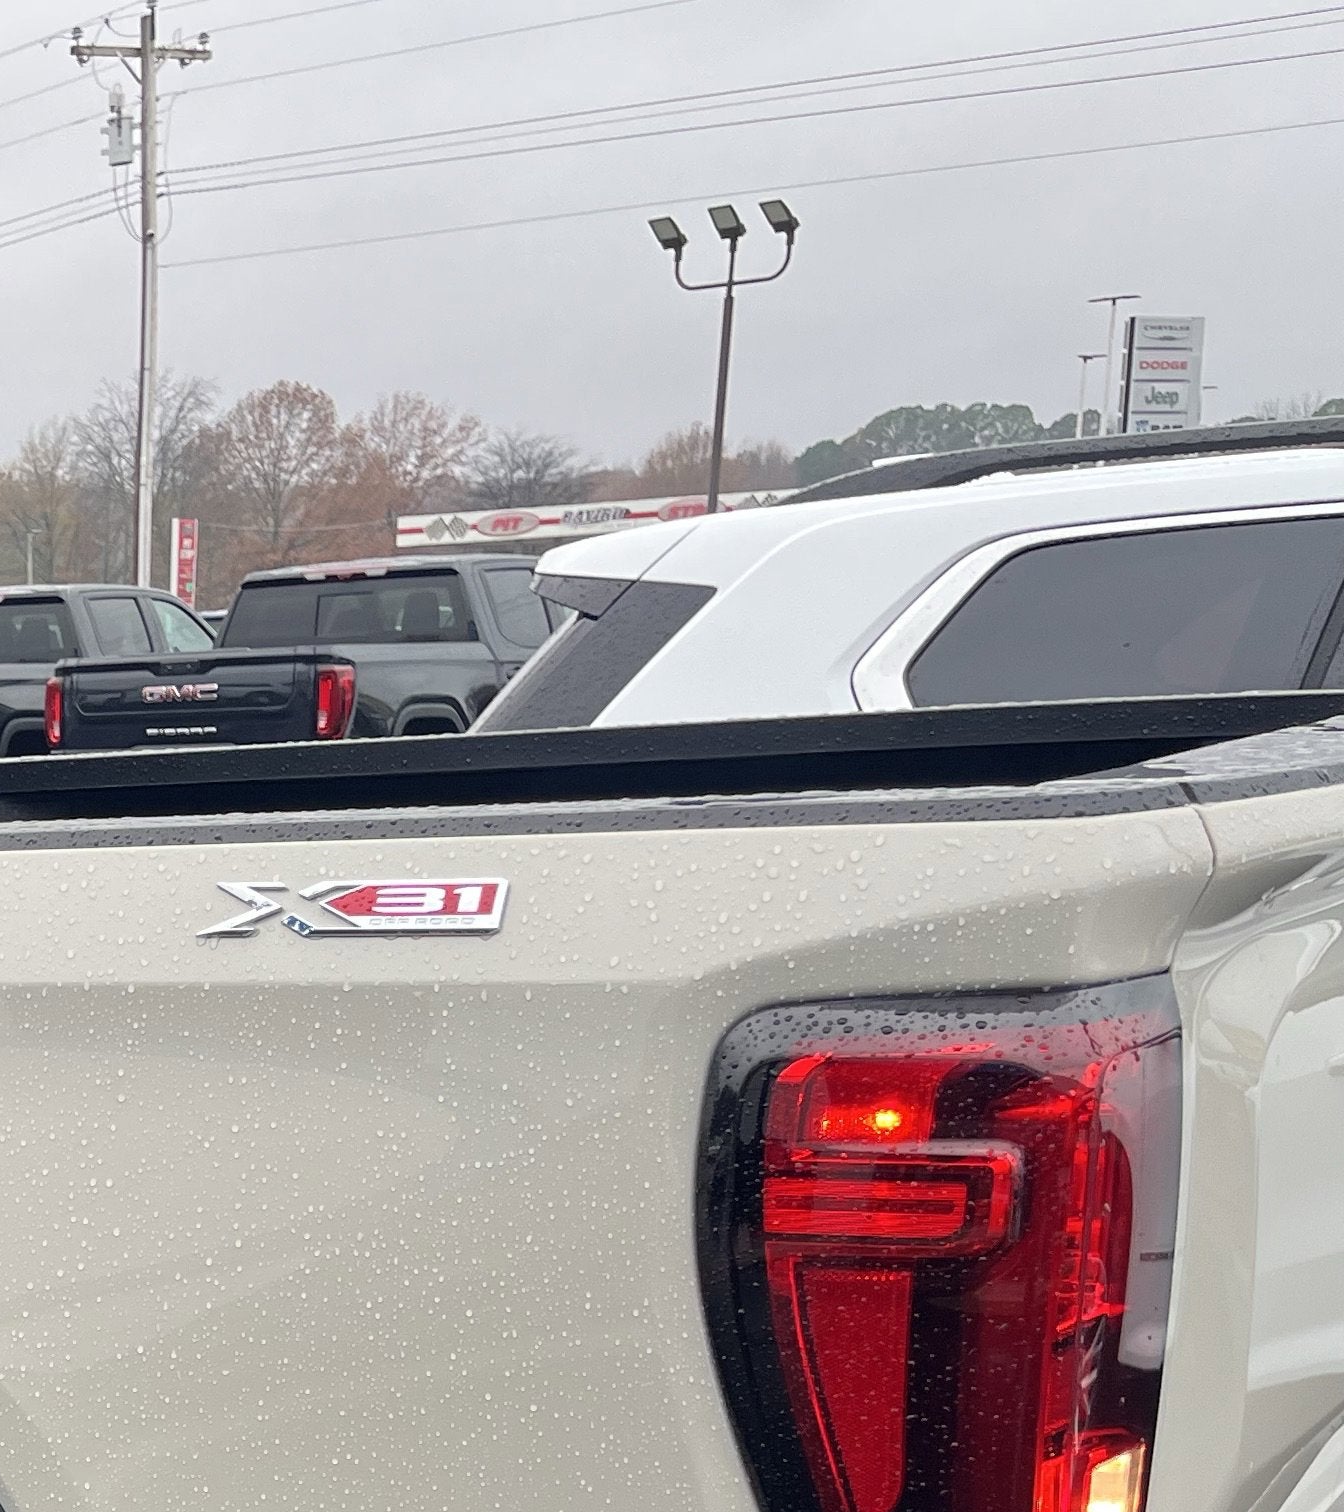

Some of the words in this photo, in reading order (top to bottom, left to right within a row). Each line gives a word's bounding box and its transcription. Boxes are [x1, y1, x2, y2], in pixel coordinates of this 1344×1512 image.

[1139, 360, 1188, 370] DODGE
[1144, 385, 1180, 409] Jeep
[141, 682, 219, 704] GMC
[414, 916, 476, 926] ROAD
